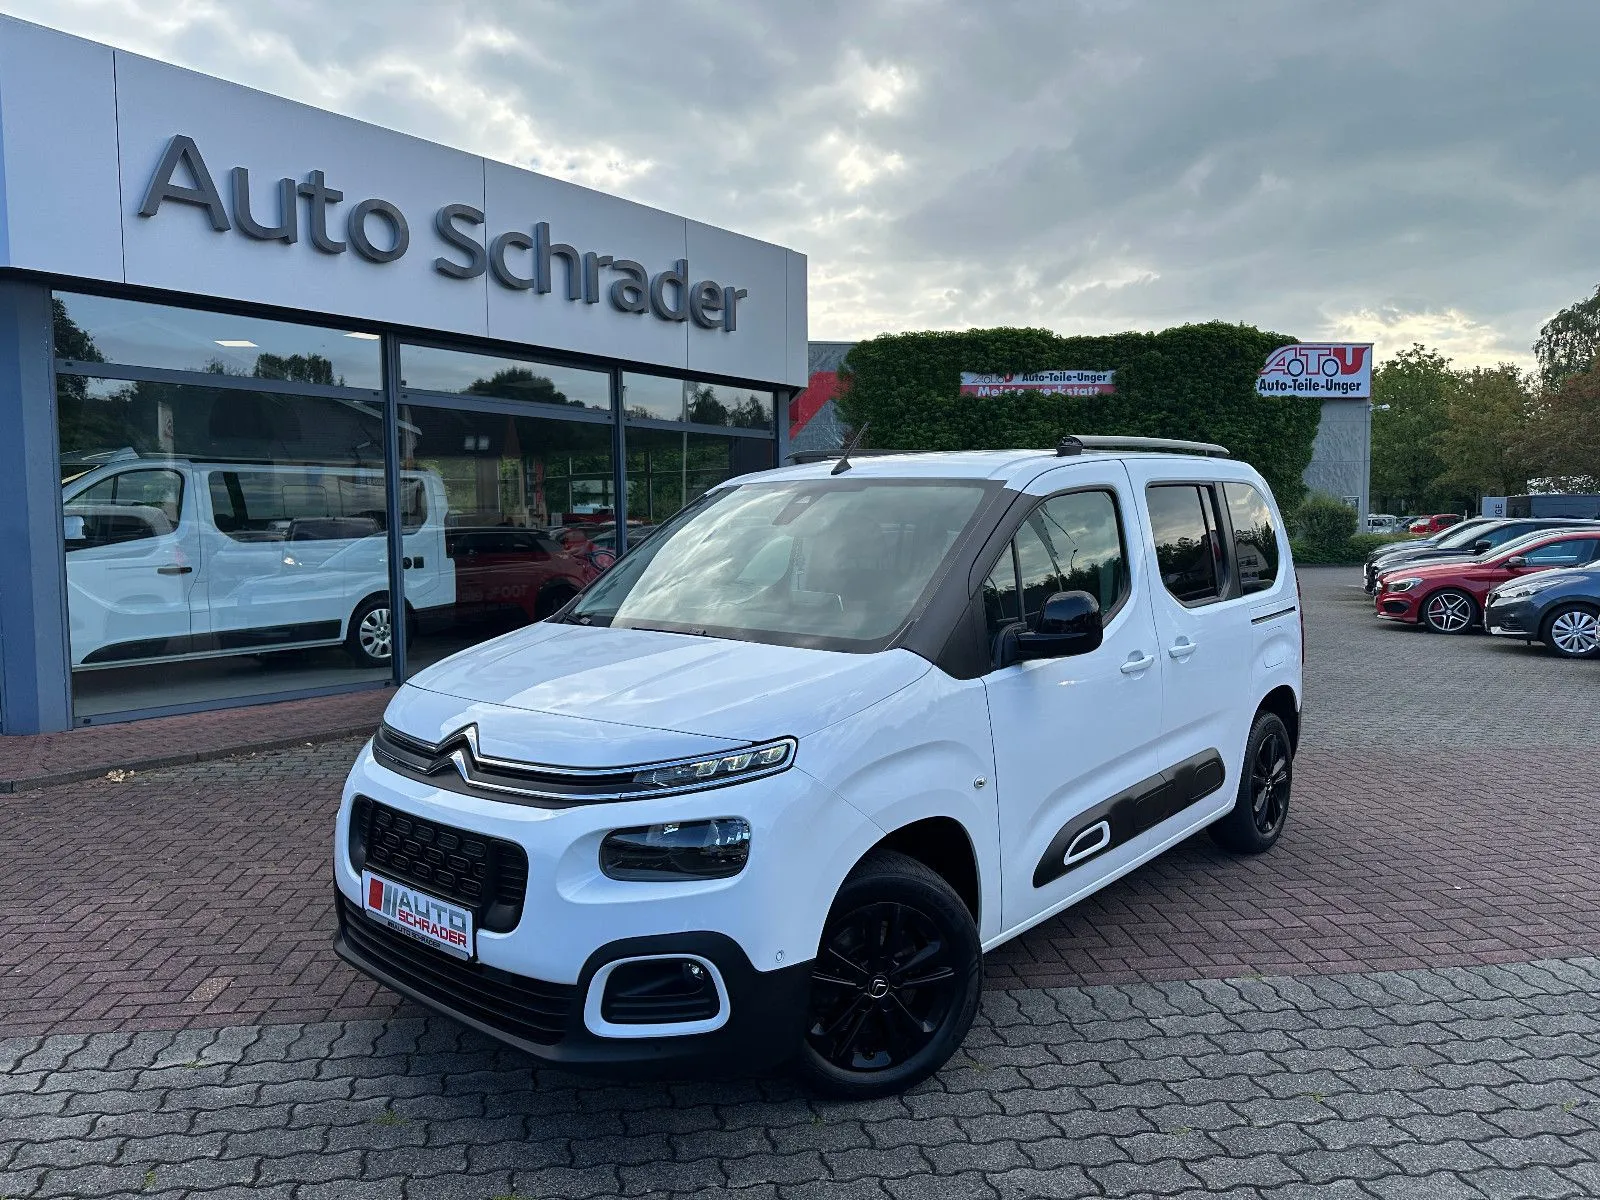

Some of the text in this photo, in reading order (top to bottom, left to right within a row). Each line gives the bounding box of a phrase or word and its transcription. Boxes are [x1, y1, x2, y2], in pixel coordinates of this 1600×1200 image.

[138, 134, 748, 332] Auto Schrader
[977, 386, 1100, 397] Meiseekstatt
[1022, 372, 1107, 384] Auto-Teile-Unger
[1258, 378, 1362, 395] Auto-Teile-Unger
[398, 890, 467, 935] AUTO
[398, 908, 467, 949] SCHRADER
